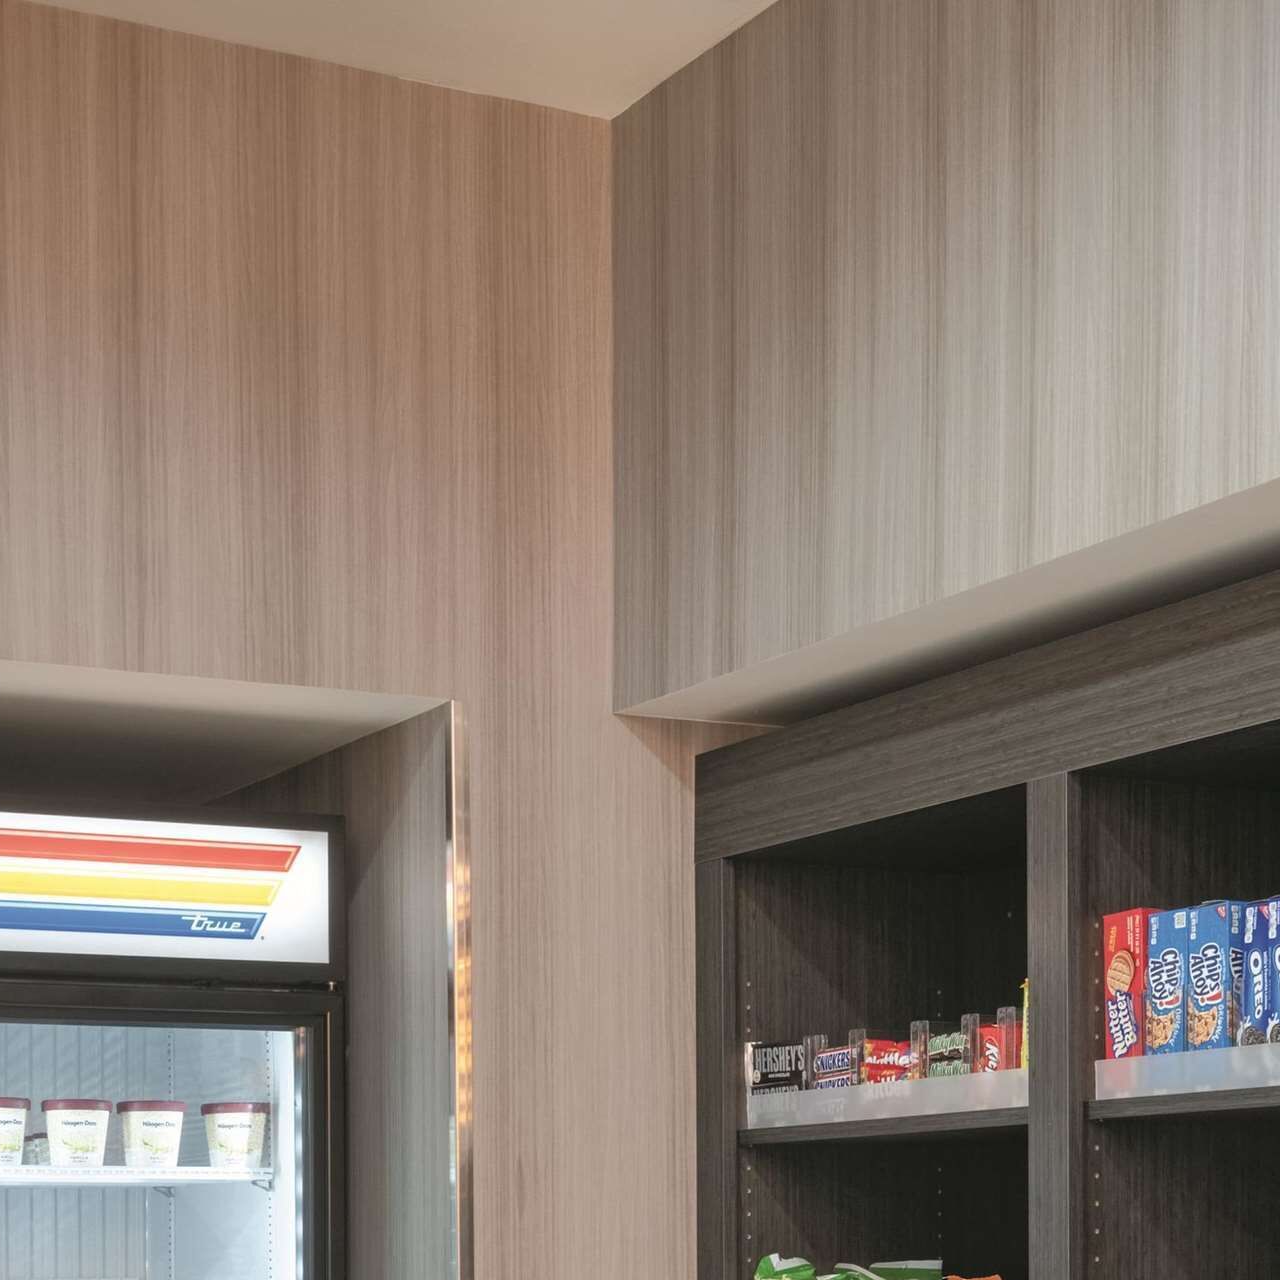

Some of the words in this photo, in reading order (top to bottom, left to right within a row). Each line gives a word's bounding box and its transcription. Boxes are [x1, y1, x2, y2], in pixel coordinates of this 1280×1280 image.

[181, 913, 247, 933] true
[1161, 948, 1179, 999] Chips
[1202, 944, 1220, 993] Chips
[1249, 950, 1264, 1019] OREO
[1108, 999, 1128, 1059] Nutter
[1116, 989, 1137, 1046] Butter
[755, 1044, 806, 1073] HERSHEY'S
[814, 1051, 850, 1073] SNICKERS
